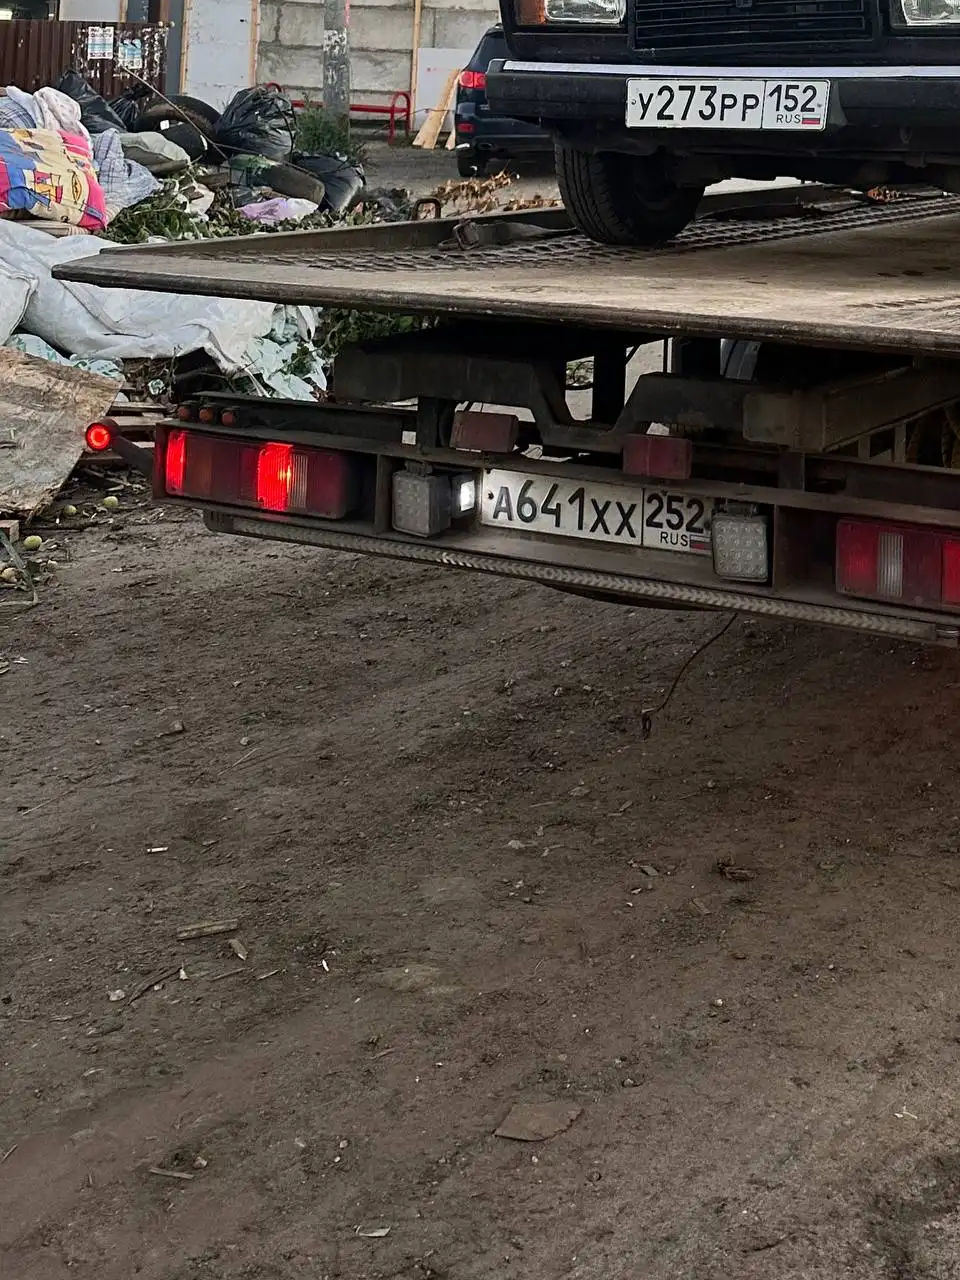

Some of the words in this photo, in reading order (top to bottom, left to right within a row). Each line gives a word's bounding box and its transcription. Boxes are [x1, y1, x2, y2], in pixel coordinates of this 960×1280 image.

[638, 85, 759, 121] У273РР
[768, 84, 817, 112] 152
[776, 113, 801, 124] RUS
[493, 479, 636, 538] А641ХХ
[645, 493, 704, 533] 252
[660, 531, 689, 548] RUS
